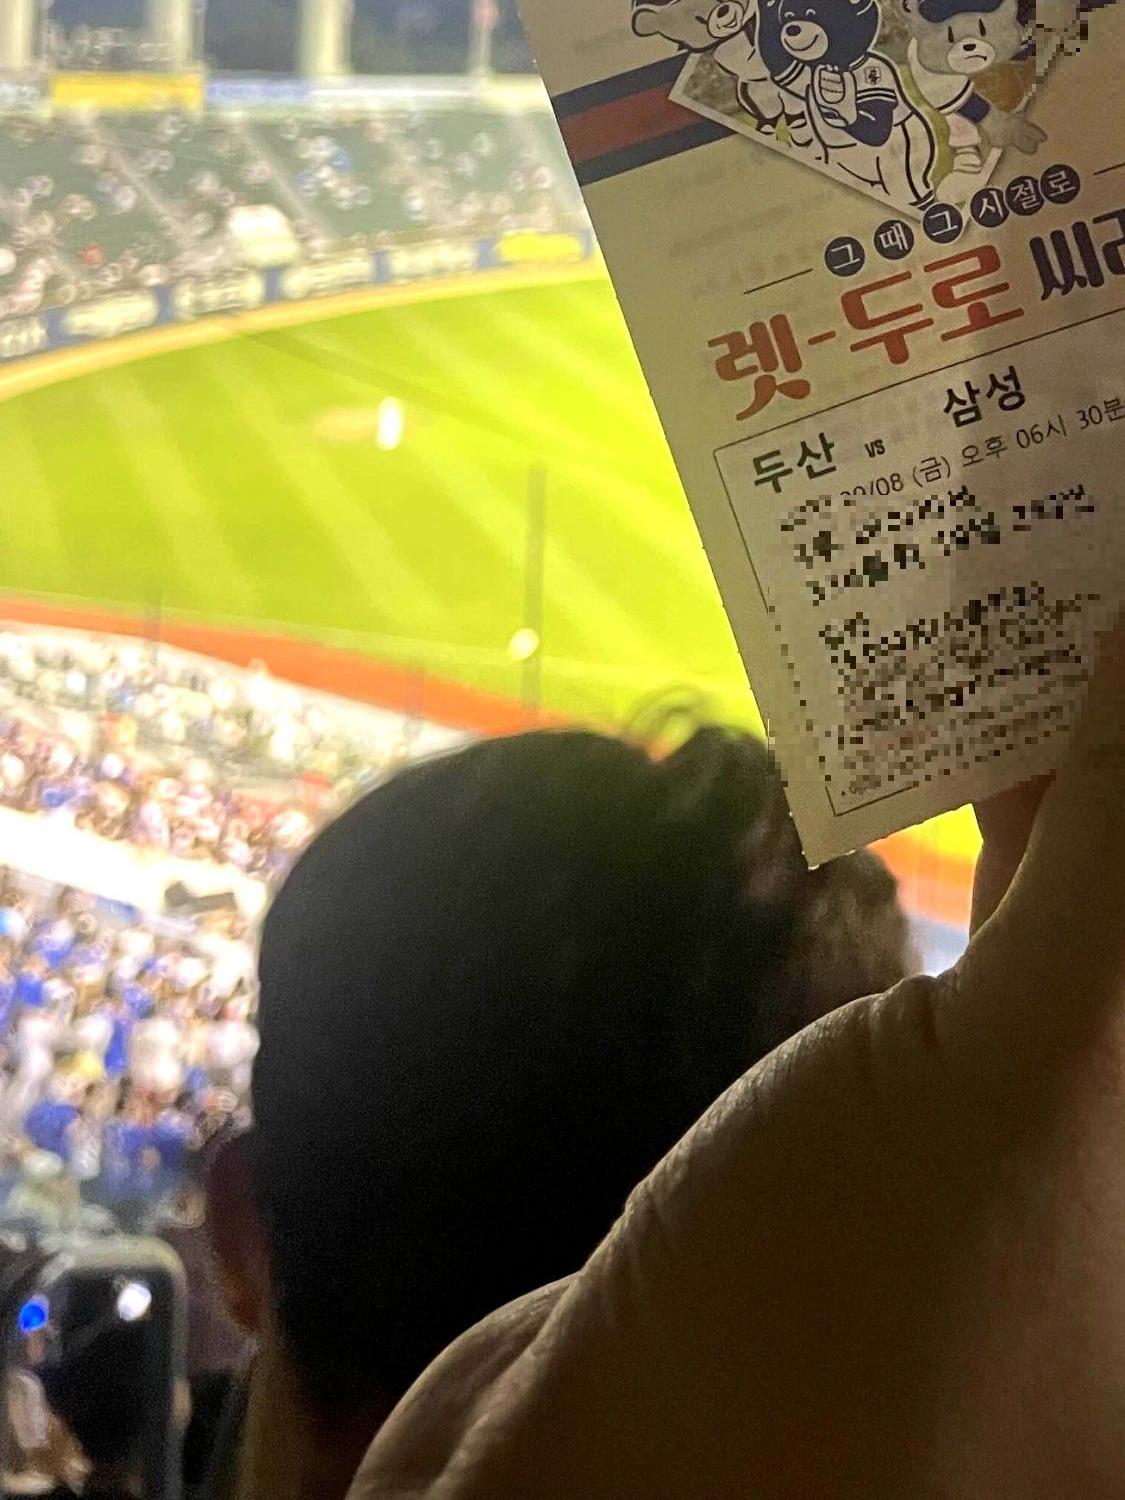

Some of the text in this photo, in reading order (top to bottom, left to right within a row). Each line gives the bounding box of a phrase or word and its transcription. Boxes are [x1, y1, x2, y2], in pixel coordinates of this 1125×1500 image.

[826, 168, 1077, 271] 그 때 그 시절로
[753, 432, 837, 493] 두산
[943, 365, 1026, 427] 삼성
[912, 456, 951, 488] (금)
[960, 435, 1006, 468] 오후
[1015, 414, 1067, 450] 06시
